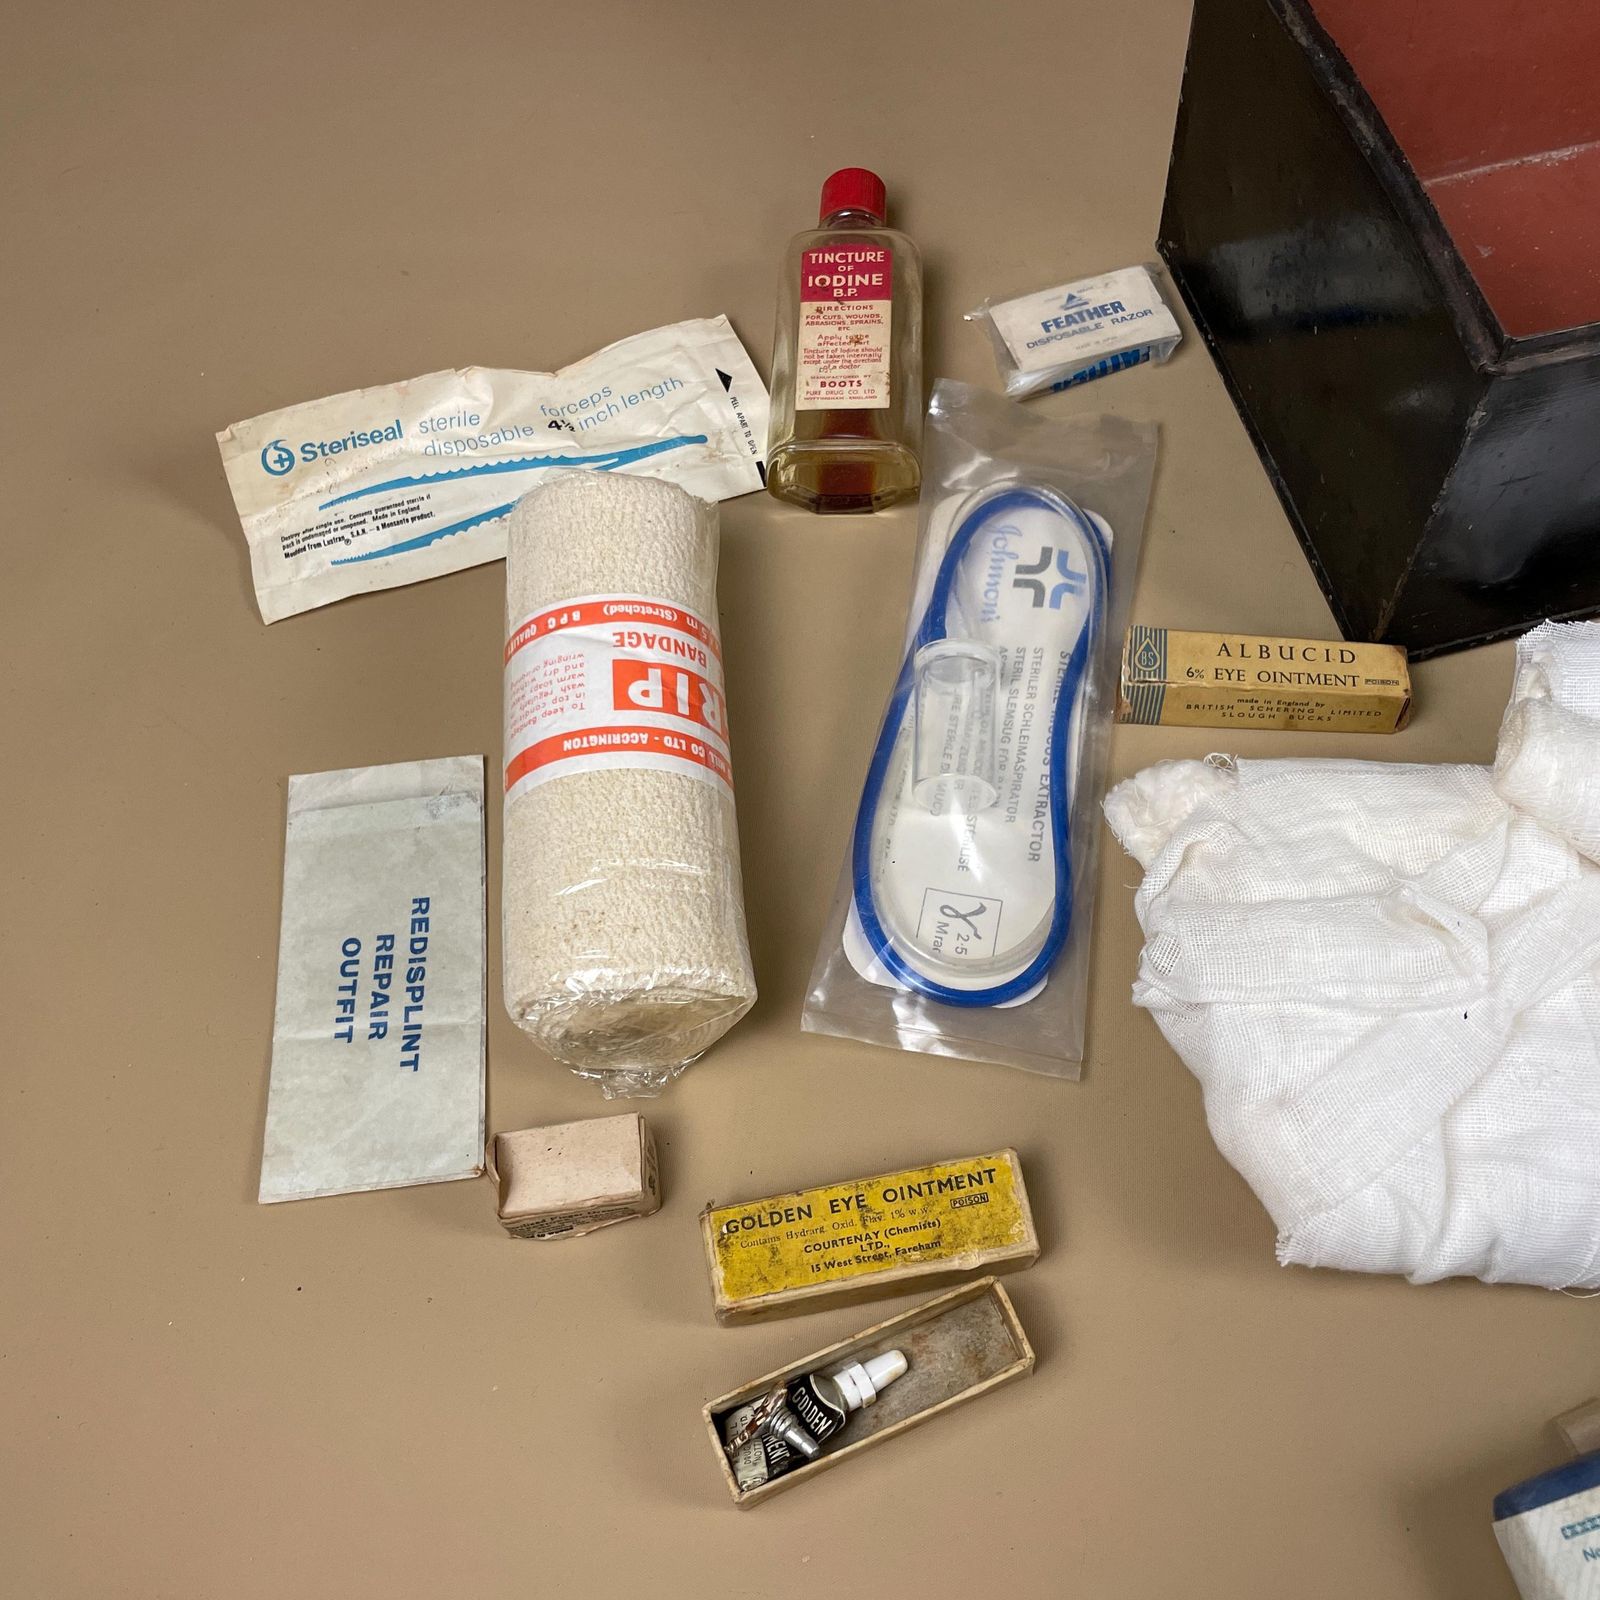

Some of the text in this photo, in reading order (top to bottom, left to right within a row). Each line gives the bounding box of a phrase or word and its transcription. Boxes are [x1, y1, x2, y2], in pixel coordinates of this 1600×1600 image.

[809, 251, 884, 264] TINCTURE
[808, 273, 884, 287] IODINE
[833, 288, 858, 297] B.P.
[1041, 300, 1126, 333] FEATHER
[817, 334, 842, 342] Apply
[1026, 309, 1153, 349] DISPOSABLE RAZOR
[820, 380, 863, 388] BOOTS
[418, 384, 613, 434] sterile forceps
[423, 423, 534, 457] disposable
[578, 401, 620, 432] inch
[621, 376, 684, 409] length
[730, 396, 758, 455] PEEL APART TO OPEN
[300, 419, 404, 463] Steriseal
[280, 532, 301, 543] Destroy
[302, 527, 314, 535] after
[315, 521, 333, 530] single
[348, 510, 373, 520] Contents
[374, 500, 405, 515] guaranteed
[406, 495, 425, 505] sterile
[282, 540, 295, 551] pack
[301, 528, 332, 543] undamaged
[372, 513, 389, 522] Made
[397, 504, 420, 516] England
[284, 545, 307, 559] Moulded
[307, 542, 322, 551] from
[381, 517, 409, 530] Monsanto
[410, 511, 436, 525] product.
[603, 603, 678, 621] (Stretched)
[686, 615, 698, 630] m
[543, 653, 585, 668] wringing
[612, 631, 707, 669] BANDAGE
[1141, 651, 1154, 666] BS
[1216, 642, 1357, 664] ALBUCID
[544, 662, 585, 677] and dry
[1009, 646, 1027, 686] STERIL
[1185, 666, 1205, 680] 6%
[1214, 667, 1246, 682] EYE
[1257, 670, 1360, 687] OINTMENT
[556, 672, 585, 683] warm
[560, 682, 585, 693] wash
[551, 695, 570, 704] top
[571, 702, 585, 710] To
[1277, 699, 1310, 707] England
[1315, 701, 1325, 709] by
[541, 705, 564, 718] keep
[1000, 688, 1019, 745] SLEMSUG
[1221, 712, 1332, 722] SLOUGH BUCKS
[1250, 705, 1315, 714] SCHERING
[1330, 709, 1382, 717] LIMITED
[563, 732, 648, 751] ACCRINGTON
[663, 735, 687, 751] LTD
[1004, 646, 1043, 824] STERILER SCHLEIMASPIRATOR
[691, 743, 706, 756] CO
[1027, 773, 1050, 862] EXTRACTOR
[334, 937, 361, 1043] OUTFIT
[368, 934, 395, 1040] REPAIR
[400, 896, 430, 1072] REDISPLINT
[725, 1168, 997, 1235] GOLDEN EYE OINTMENT
[740, 1235, 781, 1249] Contains
[832, 1219, 857, 1231] Oxid.
[890, 1209, 905, 1220] 1%
[952, 1194, 987, 1207] POISON
[803, 1218, 941, 1254] COURTENAY (Chemists)
[860, 1240, 890, 1252] LTD.,
[811, 1240, 941, 1273] 15 West Street, Fareham
[792, 1386, 833, 1436] GOLDEN
